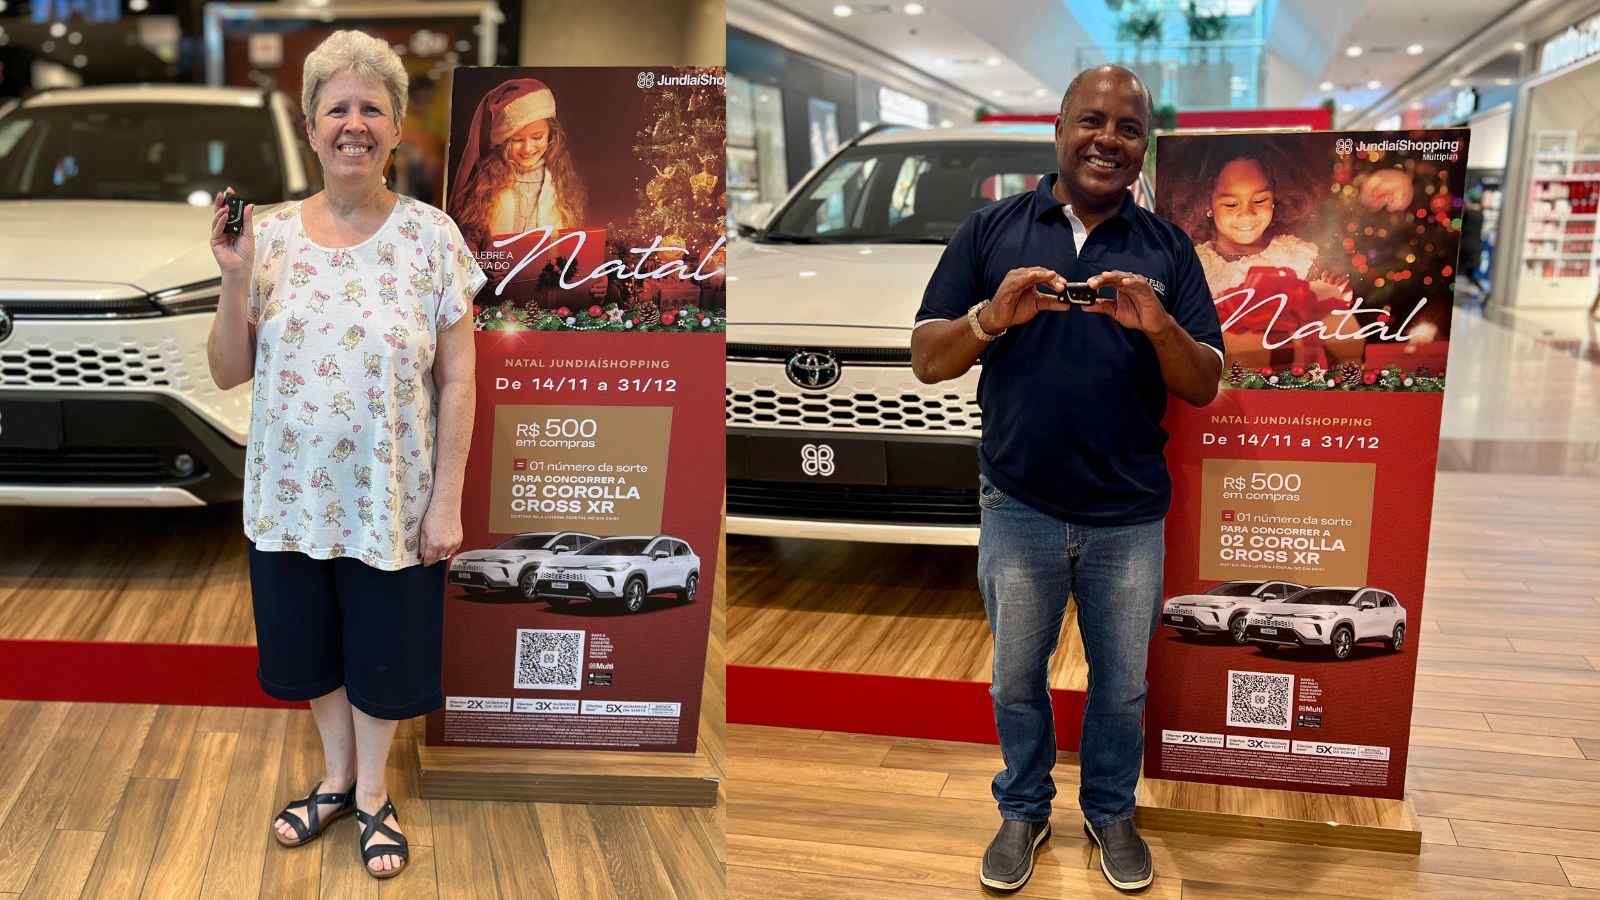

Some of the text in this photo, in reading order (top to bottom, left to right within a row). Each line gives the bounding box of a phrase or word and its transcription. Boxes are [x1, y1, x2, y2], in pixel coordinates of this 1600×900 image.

[1355, 139, 1459, 153] JundiaíShopping
[1423, 153, 1458, 162] Multiplan
[493, 226, 726, 296] Natal
[507, 251, 514, 260] A
[494, 261, 510, 270] DO
[1213, 288, 1428, 350] Natal
[505, 358, 545, 368] NATAL
[495, 377, 677, 393] De 14/11 a 31/12
[1211, 415, 1373, 427] NATAL JUNDIAÍSHOPPING
[516, 418, 597, 439] R$ 500
[515, 439, 596, 450] em compras
[1202, 433, 1380, 450] De 14/11 a 31/12
[529, 461, 649, 473] 01 número da sorte
[512, 474, 626, 484] PARA CONCORRER A
[1223, 472, 1302, 492] R$ 500
[511, 484, 640, 500] 02 COROLLA
[1222, 491, 1300, 502] em compras
[510, 499, 615, 514] CROSS XR
[1236, 512, 1353, 527] 01 número da sorte
[1220, 525, 1331, 537] PARA CONCORRER A
[1220, 534, 1346, 552] 02 COROLLA
[1219, 549, 1320, 565] CROSS XR
[467, 699, 484, 709] 2X
[535, 701, 552, 711] 3X
[605, 704, 623, 713] 5X
[1182, 734, 1198, 744] 2X
[1247, 739, 1264, 749] 3X
[1315, 745, 1333, 755] 5X
